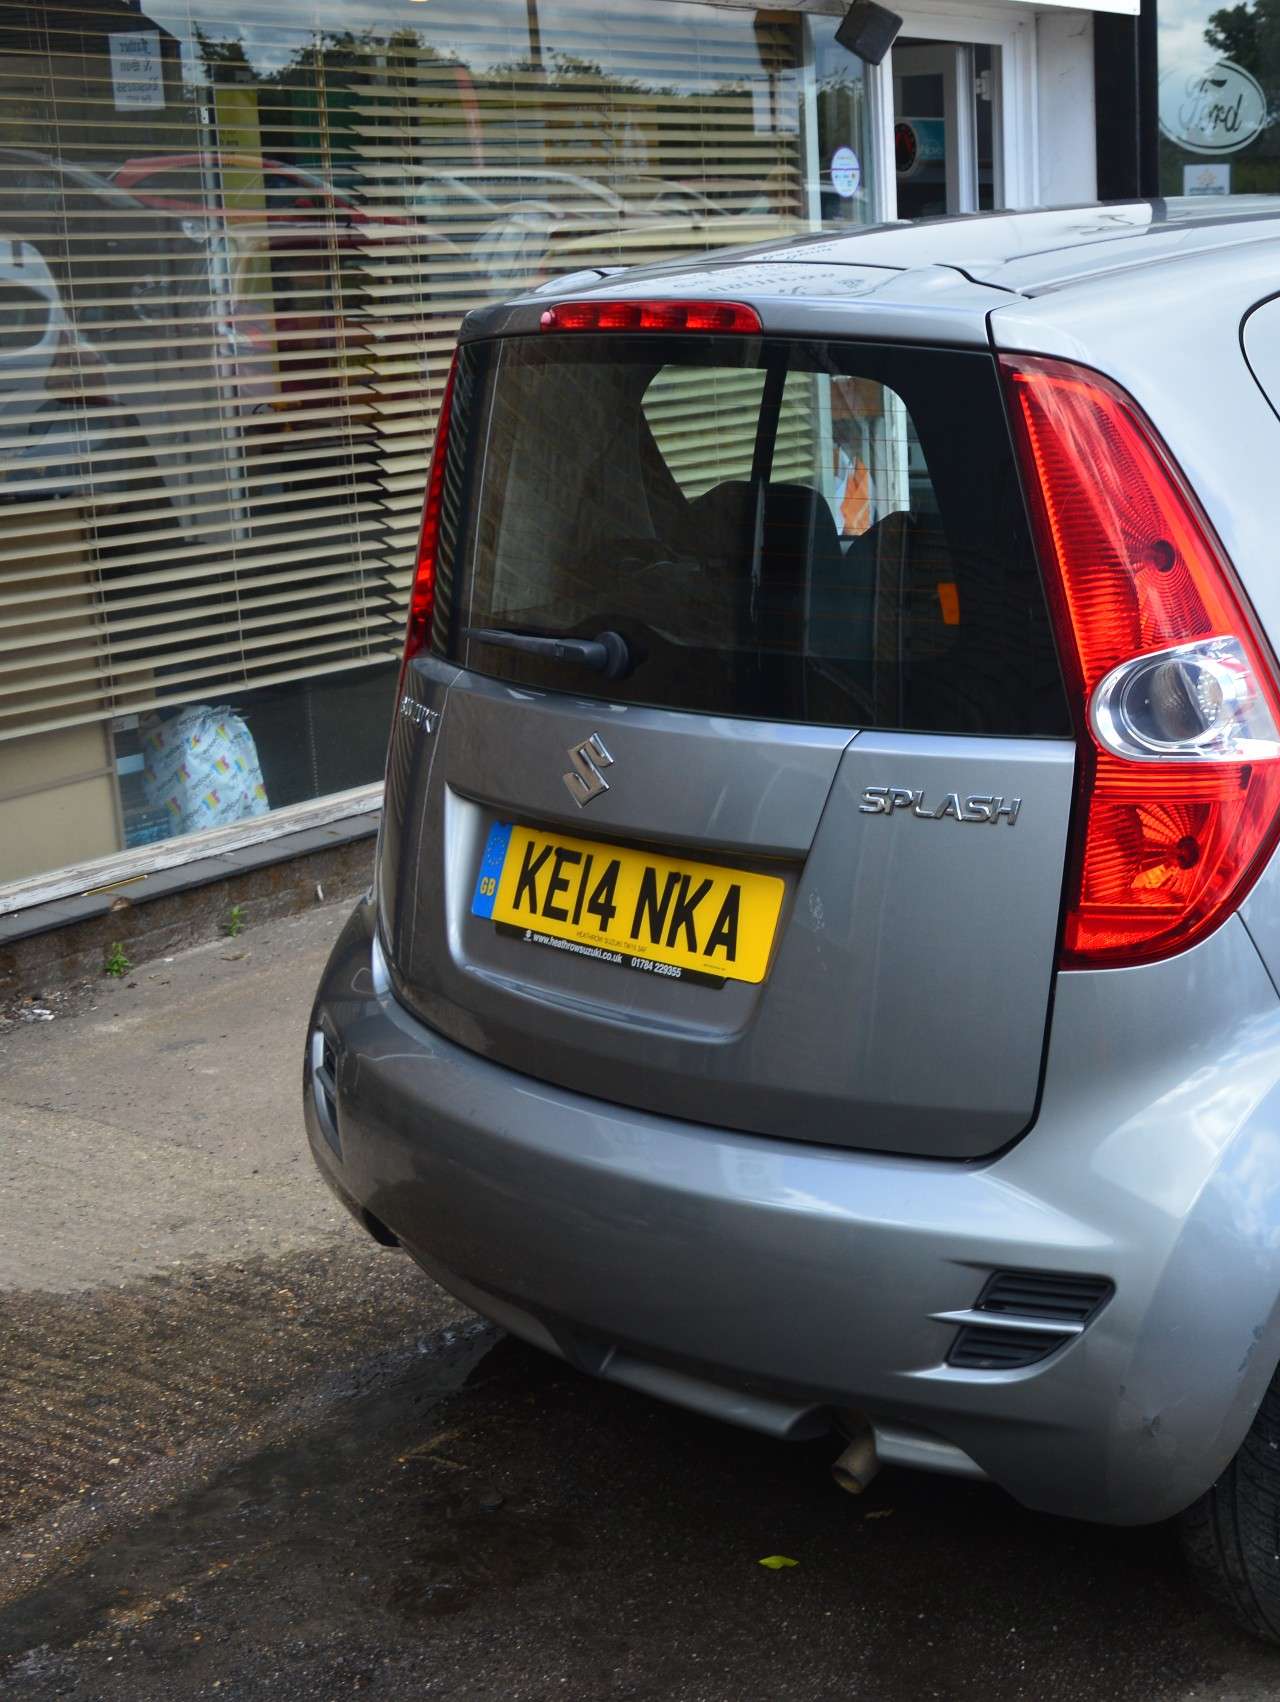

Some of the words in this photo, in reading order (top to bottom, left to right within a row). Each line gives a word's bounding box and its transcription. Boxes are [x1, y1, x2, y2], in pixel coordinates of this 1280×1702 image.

[858, 786, 1022, 826] SPLASH
[479, 876, 497, 897] GB
[512, 841, 622, 932] KE14
[629, 867, 742, 962] NKA
[533, 933, 622, 964] www.heathrowsuzuki.co.uk
[631, 957, 653, 971] 01784
